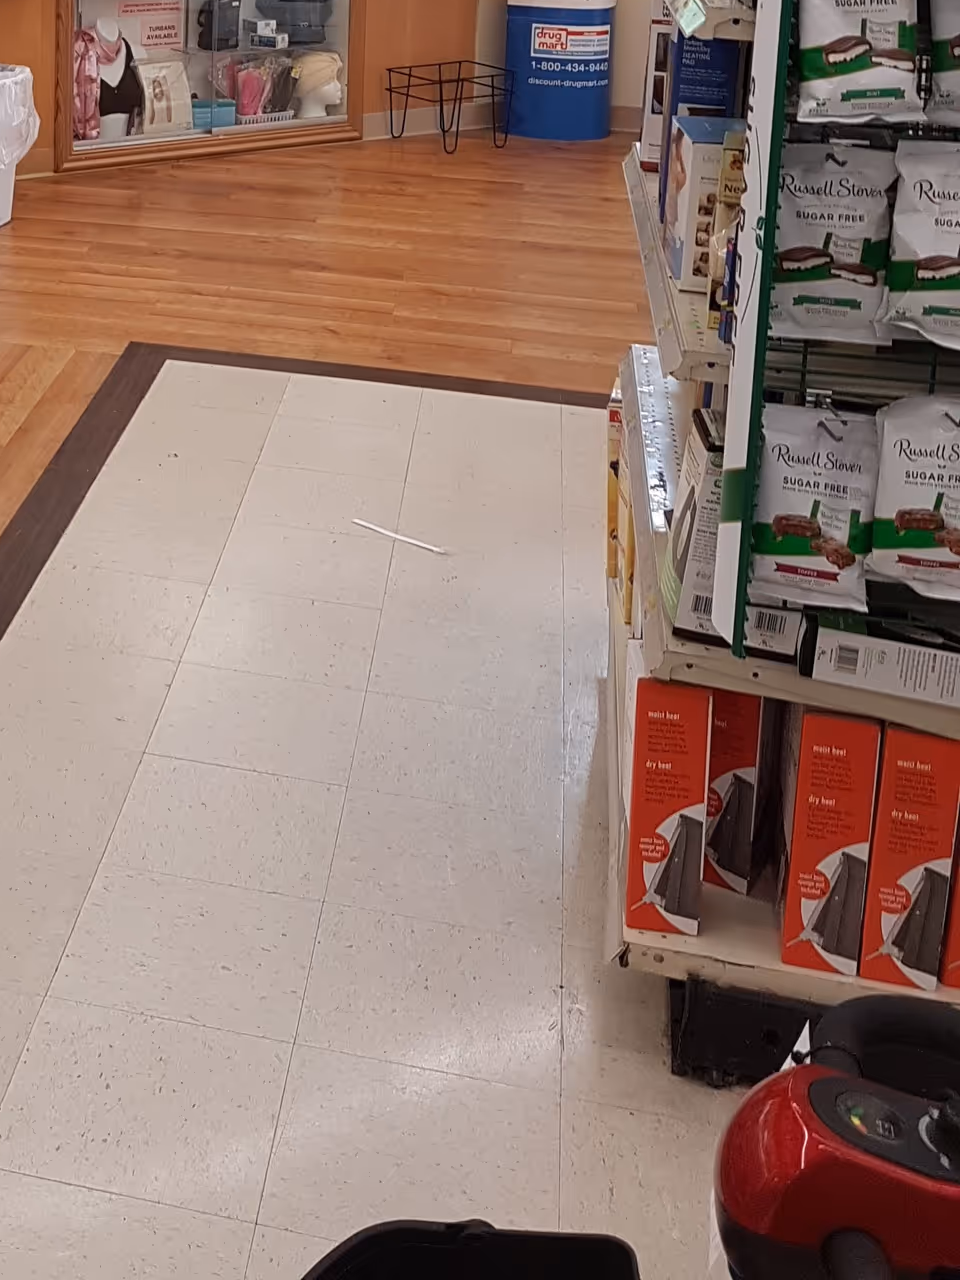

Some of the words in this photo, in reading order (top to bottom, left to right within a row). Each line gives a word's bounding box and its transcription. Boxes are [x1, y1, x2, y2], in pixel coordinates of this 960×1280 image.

[149, 24, 176, 32] TURBANS
[146, 32, 178, 40] AVAILABLE
[537, 27, 562, 42] drug
[538, 40, 567, 50] mart
[682, 52, 711, 60] HEATING
[528, 77, 609, 88] discount-drugmart.com
[781, 173, 834, 199] Russell
[835, 177, 885, 199] Stover
[796, 210, 834, 220] SUGAR
[838, 213, 865, 223] FREE
[893, 438, 946, 462] Russell
[772, 443, 820, 468] Russell
[824, 451, 863, 475] Stover
[904, 470, 945, 482] SUGAR
[783, 476, 820, 489] SUGAR
[824, 483, 849, 495] FREE
[648, 711, 665, 719] moist
[666, 712, 680, 720] heat
[813, 744, 830, 753] moist
[832, 746, 847, 757] heat
[646, 759, 657, 769] dry
[658, 761, 672, 769] heat
[897, 759, 915, 768] moist
[917, 761, 932, 771] heat
[808, 794, 820, 805] dry
[821, 796, 836, 806] heat
[891, 809, 903, 819] dry
[904, 810, 919, 821] heat
